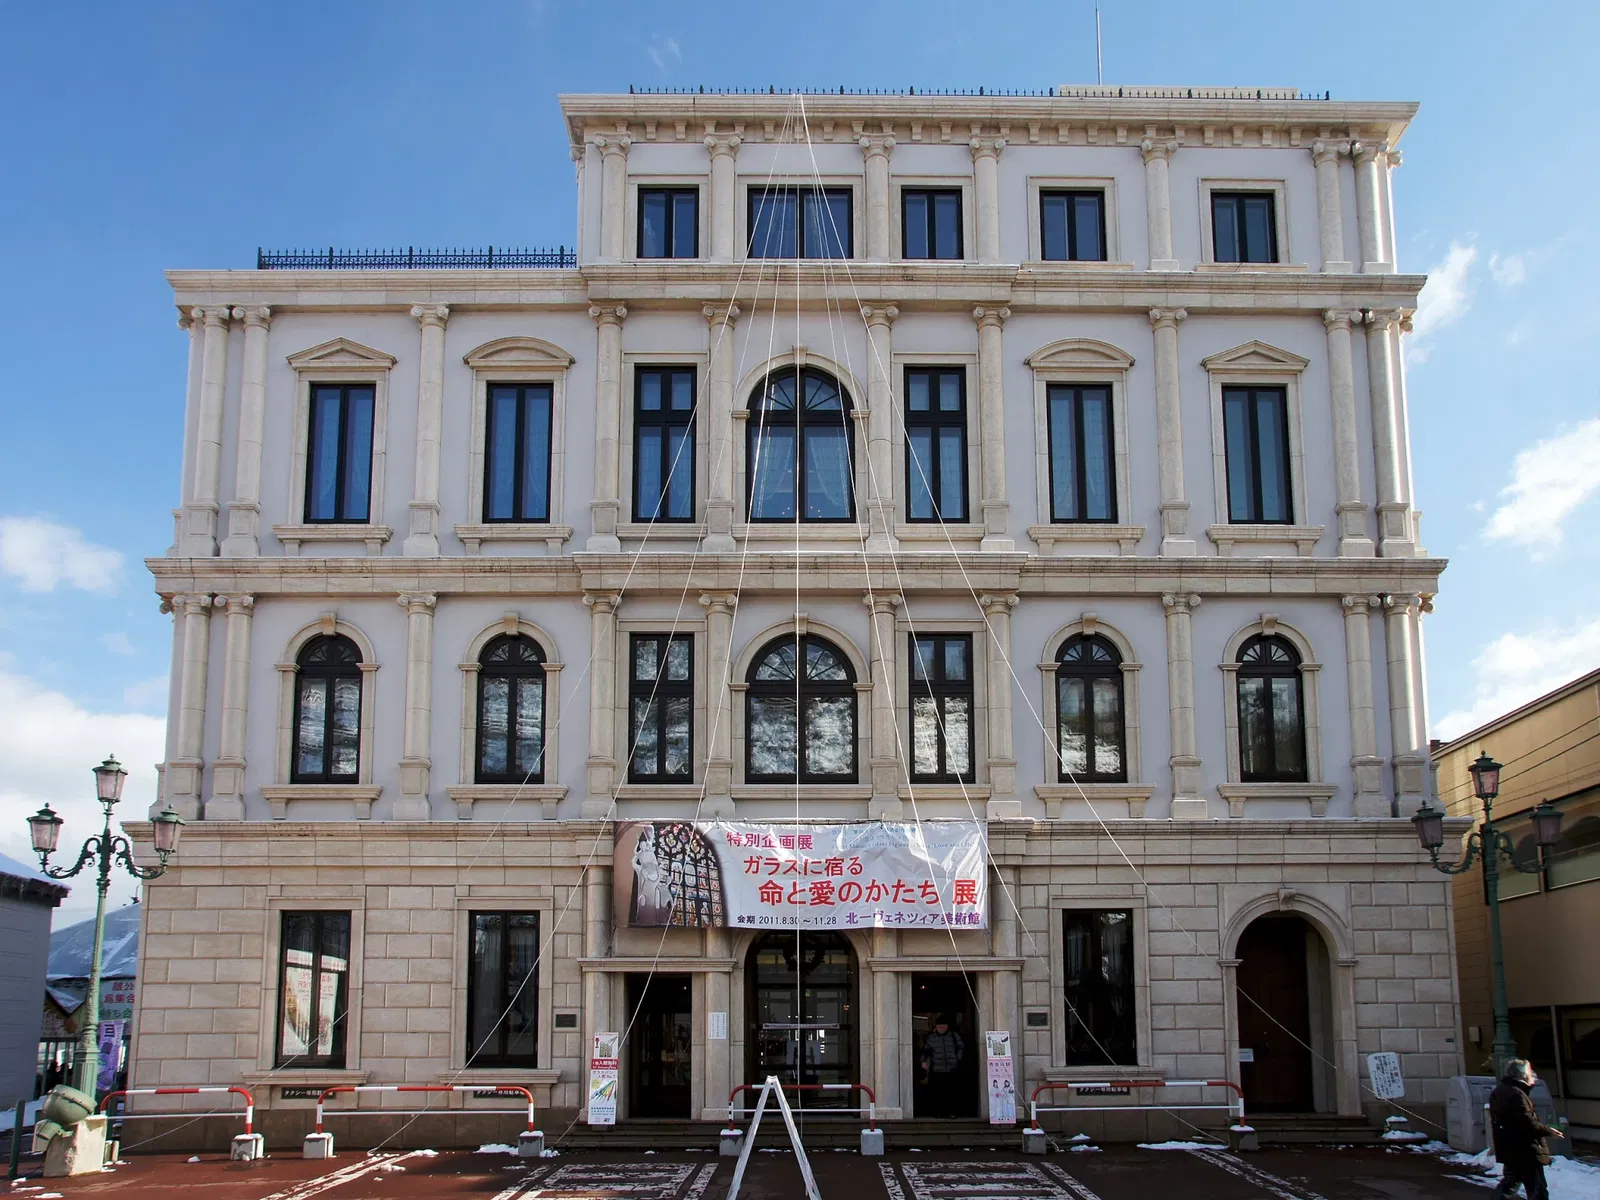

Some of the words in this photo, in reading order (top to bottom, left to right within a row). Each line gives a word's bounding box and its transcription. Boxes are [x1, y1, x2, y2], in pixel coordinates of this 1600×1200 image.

[726, 831, 813, 850] 特別企画展
[743, 855, 864, 877] ガラスに宿る
[758, 878, 939, 906] 命と愛のかたち
[952, 879, 978, 905] 展
[737, 915, 755, 924] 会期
